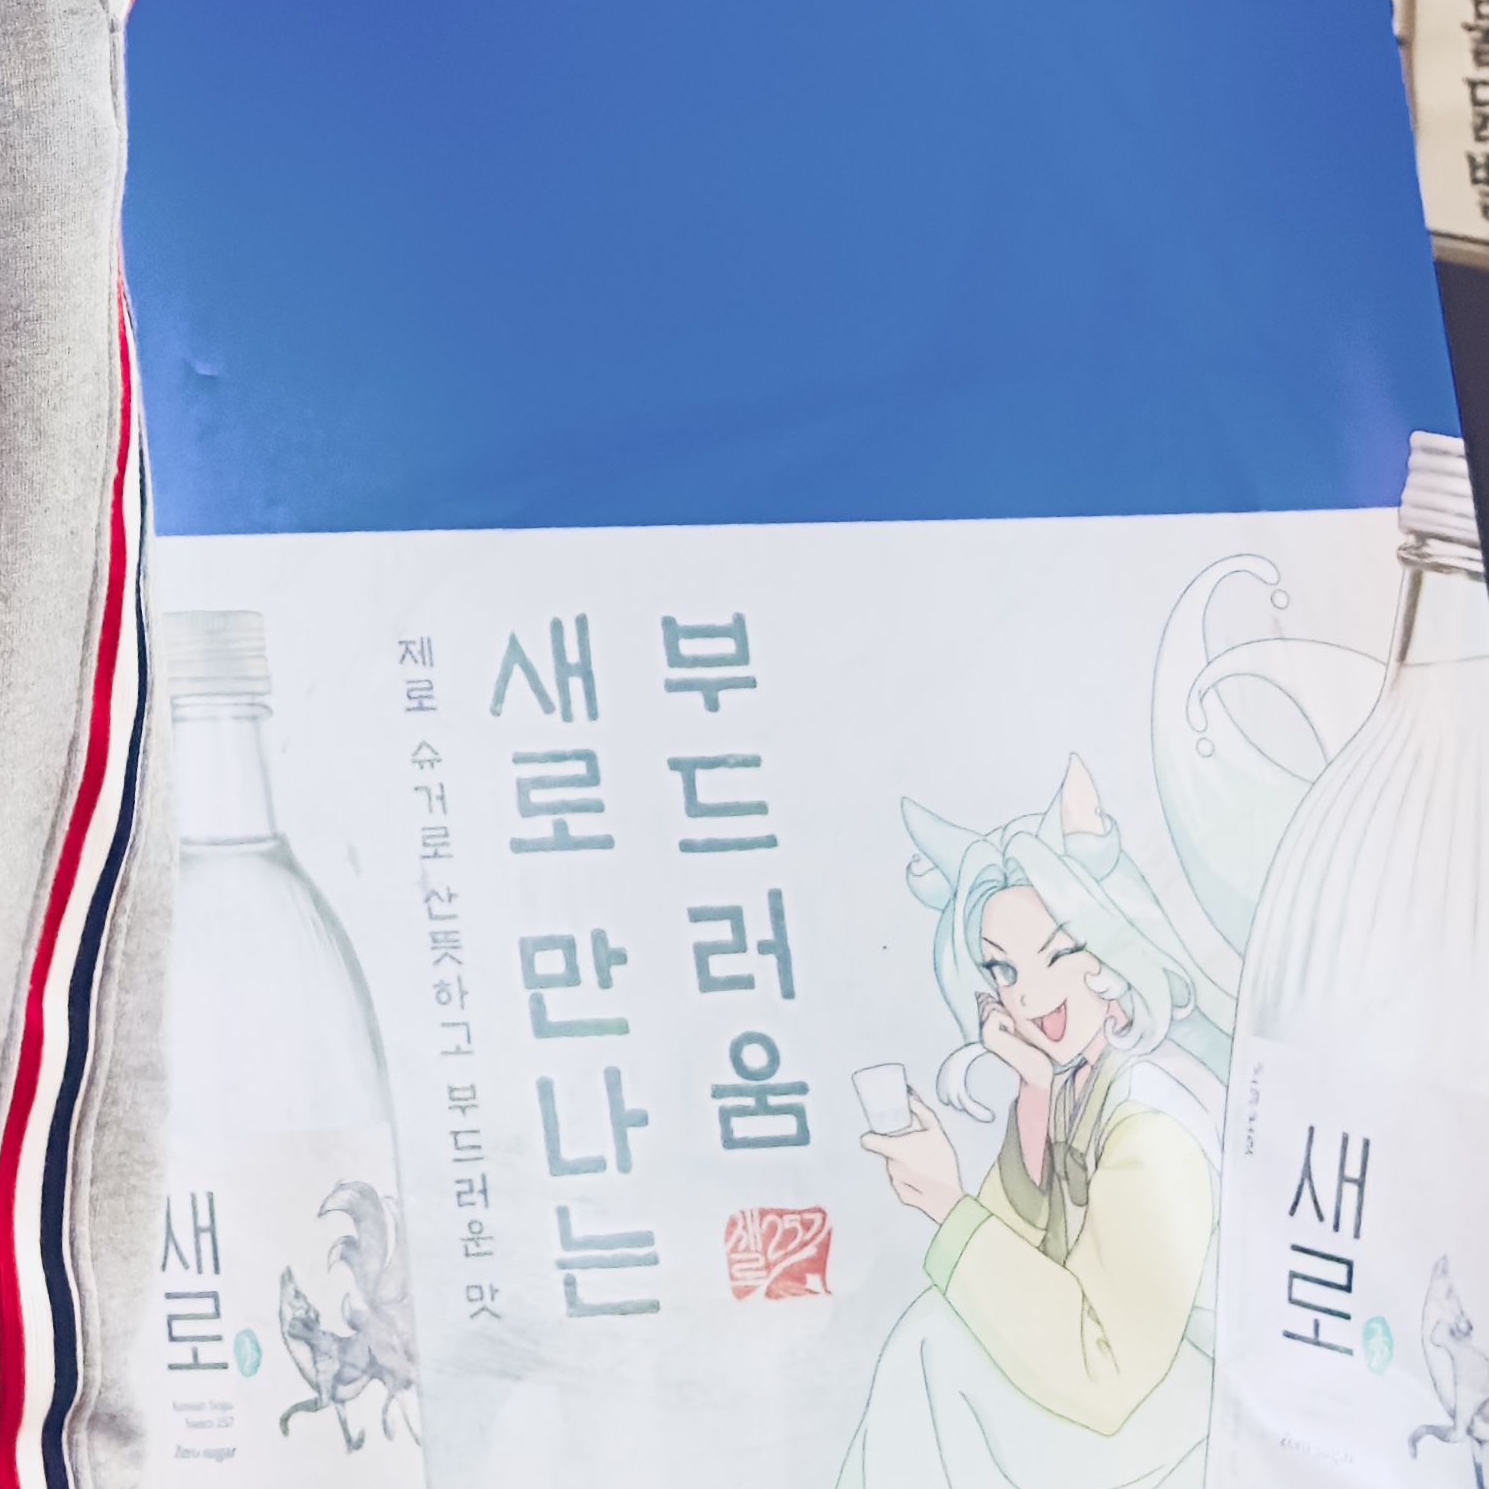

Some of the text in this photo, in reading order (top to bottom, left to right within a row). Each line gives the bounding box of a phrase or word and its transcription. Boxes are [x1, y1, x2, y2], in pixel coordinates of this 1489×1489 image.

[398, 637, 502, 1320] 제로 슈거로 산뜻하고 부드러운 맛
[490, 613, 659, 1318] 새로 만나는
[661, 612, 810, 1150] 부드러움
[161, 1191, 229, 1371] 새로
[1282, 1125, 1370, 1356] 새로
